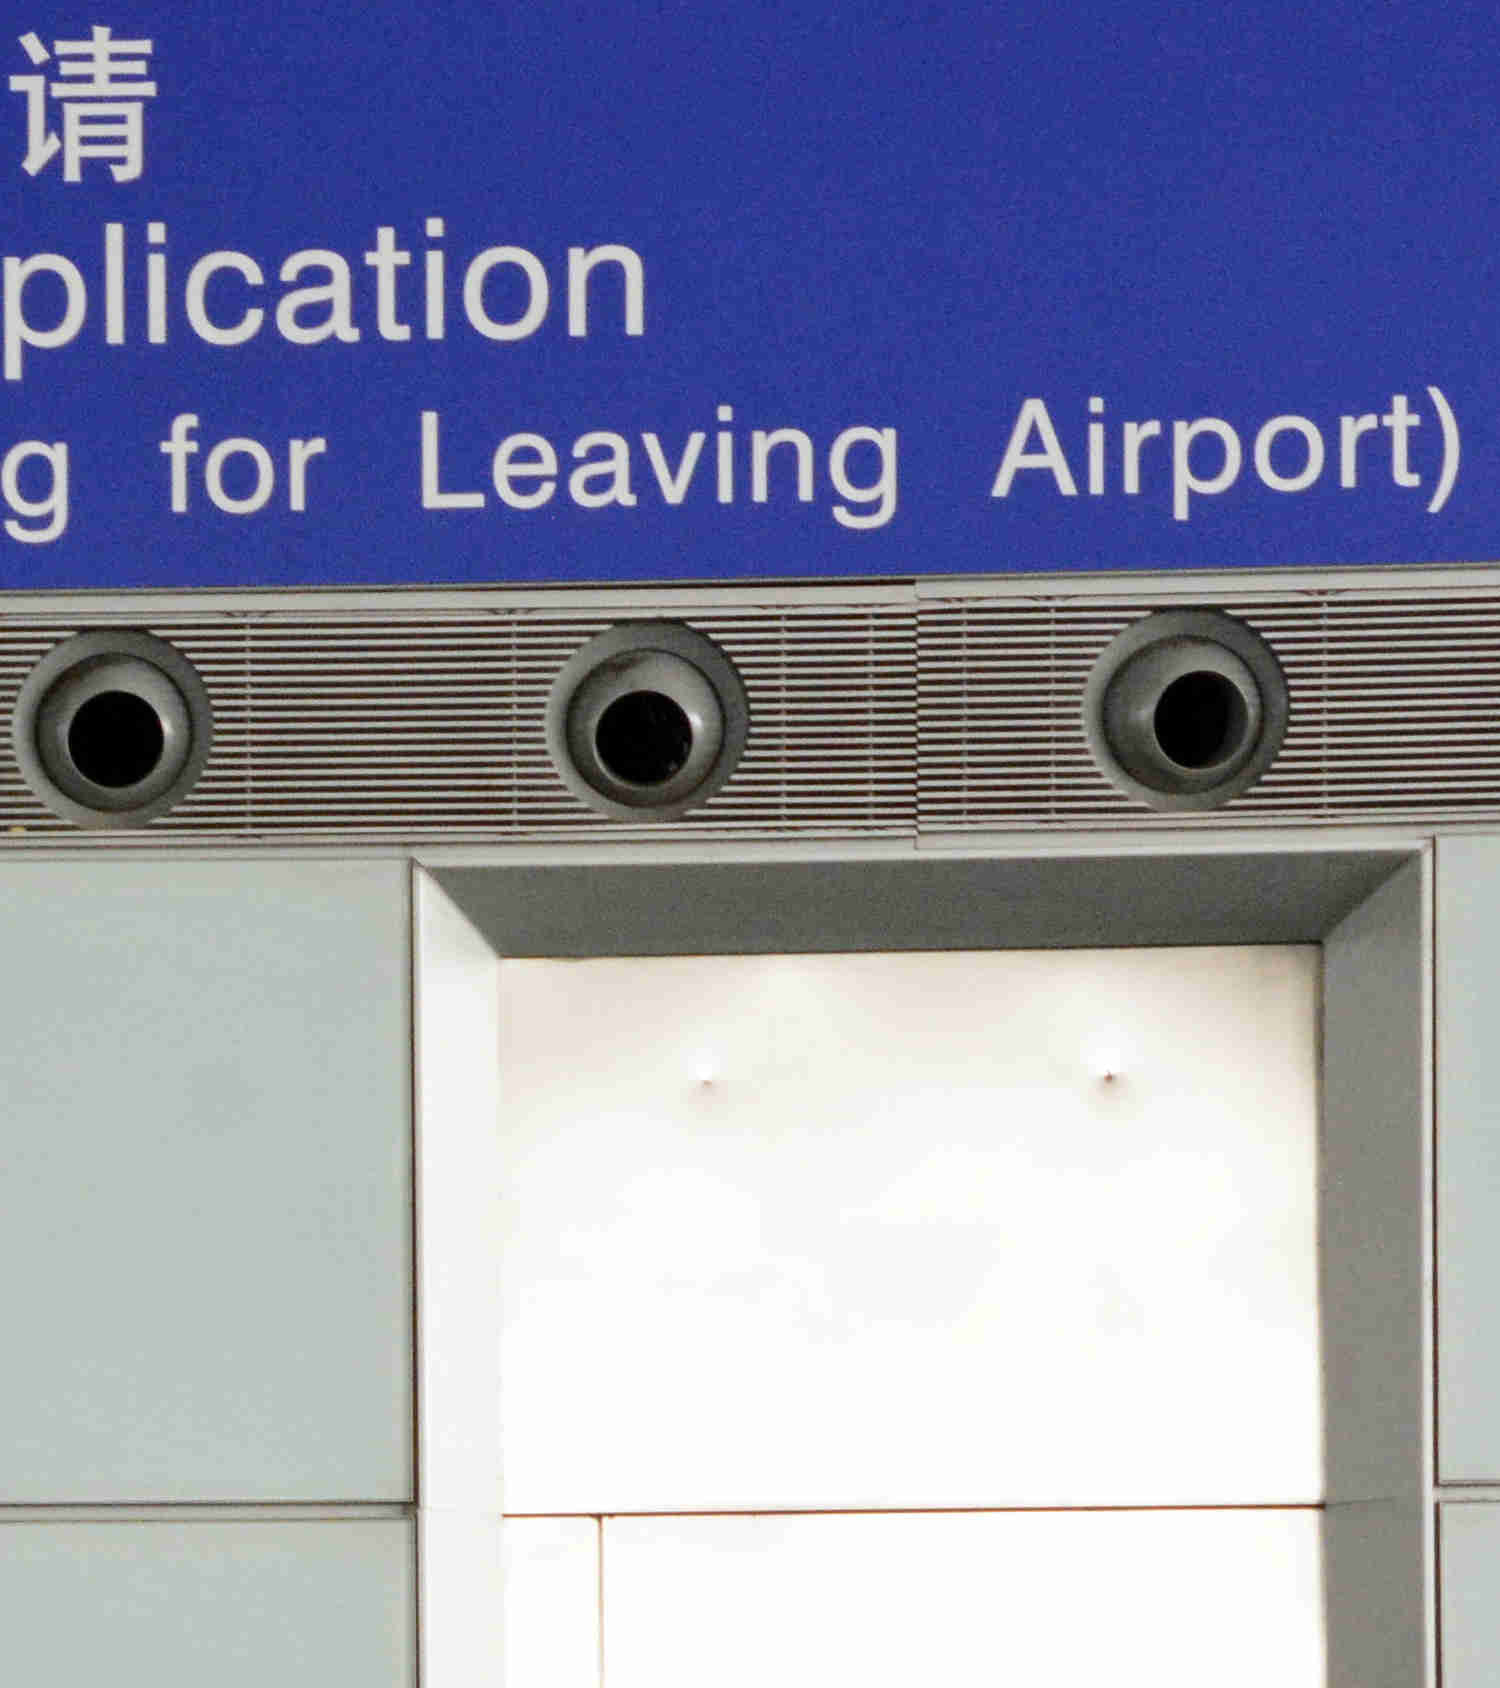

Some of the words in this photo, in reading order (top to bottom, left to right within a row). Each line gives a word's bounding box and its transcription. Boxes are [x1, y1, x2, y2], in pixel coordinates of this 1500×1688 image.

[160, 414, 326, 514] for
[421, 411, 897, 529] Leaving
[992, 386, 1460, 521] Airport)
